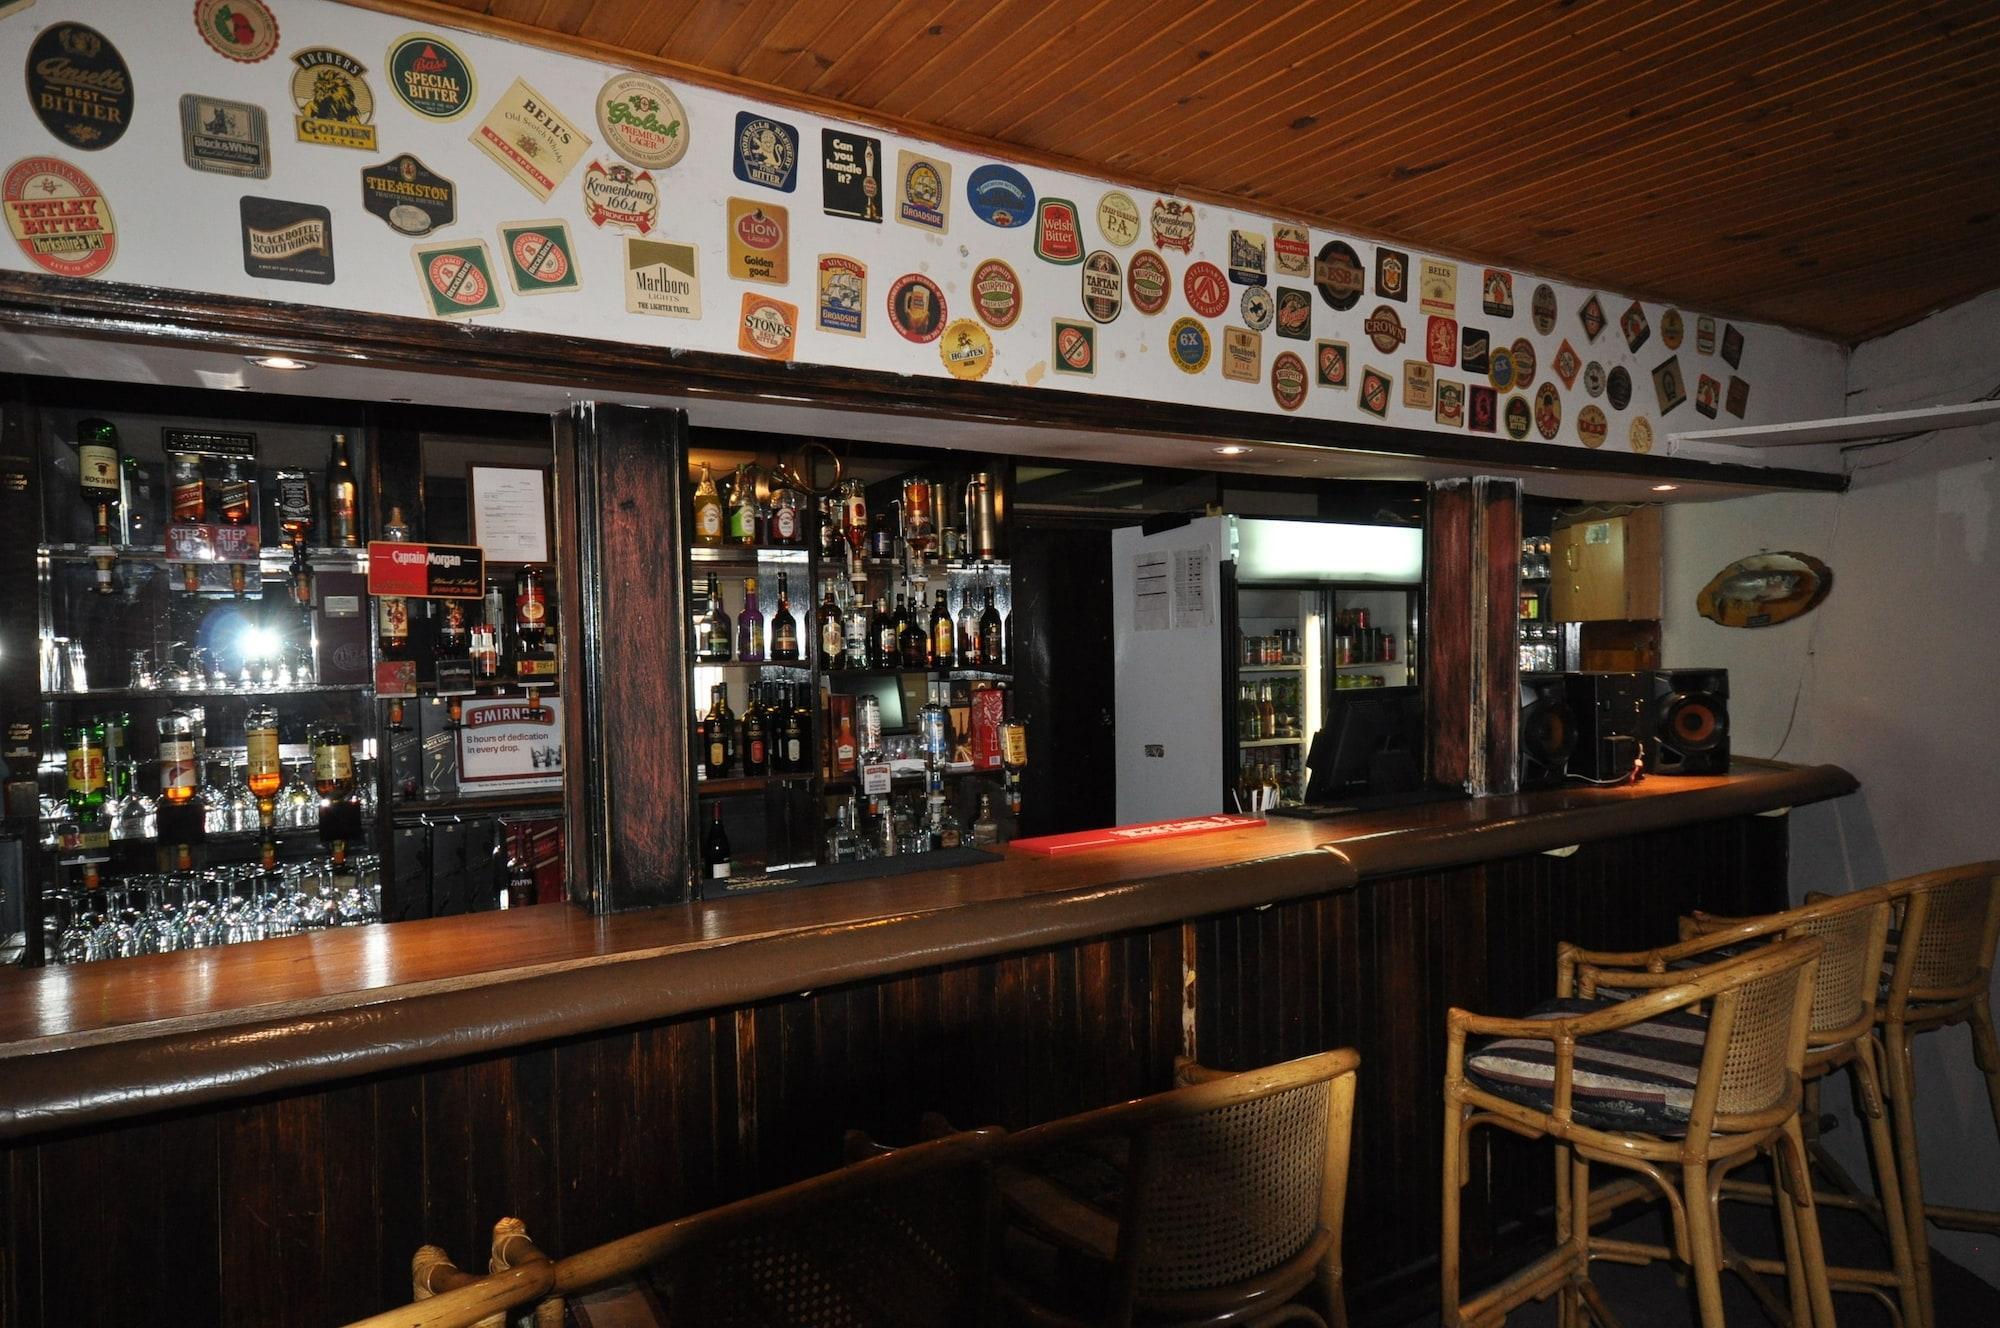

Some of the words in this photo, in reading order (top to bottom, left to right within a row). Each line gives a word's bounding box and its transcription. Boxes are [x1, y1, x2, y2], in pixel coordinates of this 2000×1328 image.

[300, 51, 360, 75] ARCHERS
[36, 57, 125, 94] Ansells
[404, 71, 460, 92] SPECIAL
[64, 86, 99, 102] BEST
[409, 85, 458, 104] BITTER
[41, 93, 122, 124] BITTER
[522, 98, 572, 145] BELL'S
[607, 100, 680, 138] Grolsch
[621, 125, 665, 144] PREMIUM
[628, 135, 657, 149] LAGER
[833, 139, 854, 152] Can
[487, 132, 515, 156] EXTRA
[515, 156, 548, 185] SPECIAL
[833, 151, 854, 163] you
[826, 159, 862, 175] handle
[752, 168, 780, 184] BITTER
[837, 172, 851, 184] it?
[367, 177, 448, 200] THEAKSTON
[587, 177, 653, 203] Kronenbourg
[11, 200, 97, 218] TETLEY
[607, 196, 637, 213] 1664
[599, 208, 624, 222] STRONG
[624, 213, 644, 223] LAGER
[903, 204, 941, 225] BROADSIDE
[1153, 211, 1193, 231] Kronenbourg
[20, 216, 103, 235] BITTER
[742, 222, 777, 237] LION
[1043, 217, 1073, 231] Welsh
[1108, 215, 1132, 237] P.A.
[1164, 226, 1184, 238] 1664
[253, 233, 285, 245] BLACK
[284, 224, 321, 241] BOTTLE
[1045, 230, 1073, 242] Bitter
[34, 237, 87, 253] Yorkshire's
[253, 243, 288, 255] SCOTCH
[287, 234, 321, 250] WHISKY
[744, 256, 774, 268] Golden
[636, 267, 690, 296] Marlboro
[1086, 275, 1119, 290] TARTAN
[1328, 266, 1352, 285] ESB
[1090, 286, 1114, 298] SPECIAL
[638, 302, 649, 311] THE
[650, 303, 672, 313] LIGHTER
[822, 309, 859, 324] BROADSIDE
[744, 314, 792, 338] STONES
[1365, 320, 1405, 340] CROWN
[1180, 333, 1198, 346] 6X
[951, 347, 984, 361] HOSTEN
[170, 528, 198, 540] STEP
[217, 528, 246, 540] STEP
[392, 550, 426, 565] Captain
[425, 552, 461, 568] Morgan
[473, 734, 497, 744] hours
[497, 733, 507, 742] of
[507, 732, 549, 742] dedication
[467, 746, 476, 754] in
[476, 746, 499, 754] every
[510, 879, 533, 887] ZAPPA
